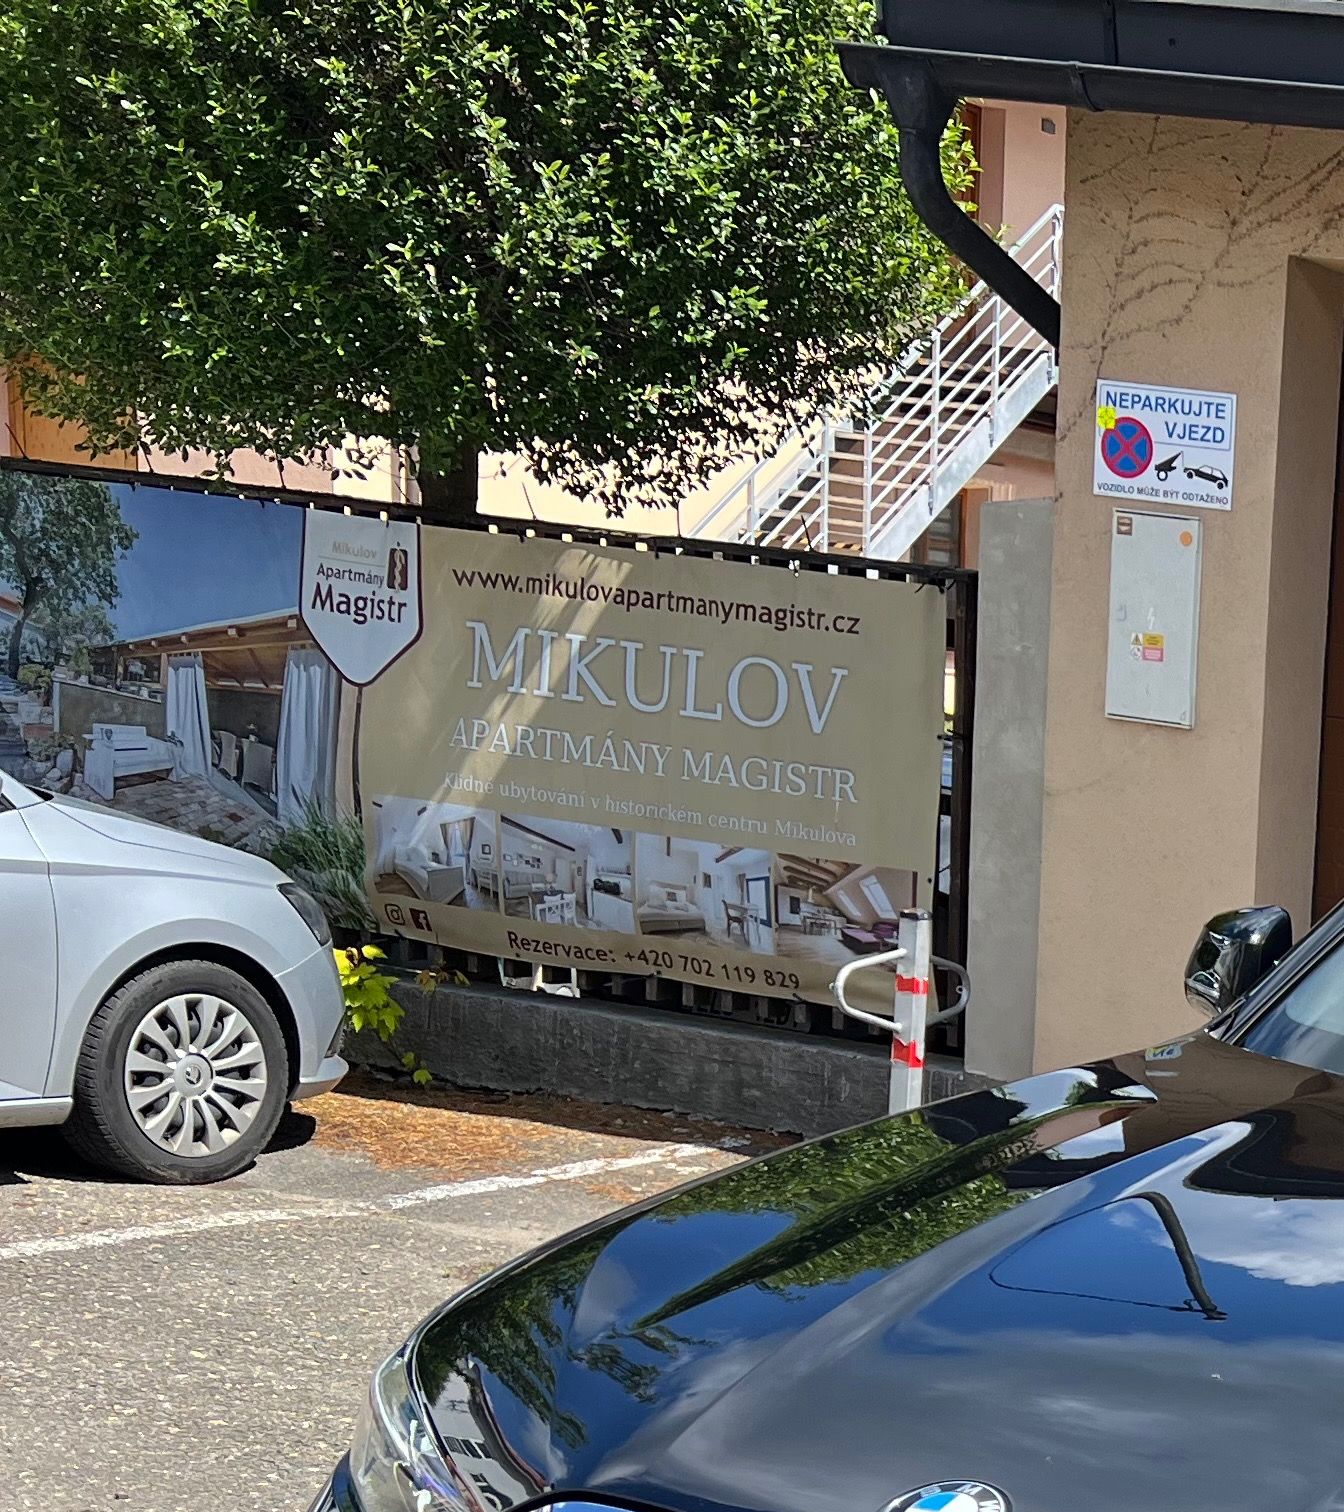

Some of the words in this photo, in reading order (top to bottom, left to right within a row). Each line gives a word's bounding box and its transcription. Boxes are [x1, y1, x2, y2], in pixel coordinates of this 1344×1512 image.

[1105, 390, 1227, 420] NEPARKUJTE
[1164, 420, 1226, 444] VJEZD
[1096, 481, 1135, 494] VOZIDLO
[1162, 487, 1180, 500] BÝT
[1181, 491, 1229, 505] ODTAŽENO
[331, 541, 378, 560] Mikulov
[316, 561, 385, 589] Apartmány
[311, 581, 408, 626] Magistr
[451, 567, 861, 636] www.mikulovapartmanymagistr.cz
[464, 620, 849, 735] MIKULOV
[449, 716, 673, 777] APARTMÁNY
[680, 748, 859, 804] MAGISTR
[499, 781, 586, 808] ubytování
[590, 795, 601, 810] v
[604, 793, 702, 825] historickém
[708, 813, 768, 834] centru
[774, 819, 857, 847] Mikulova
[506, 930, 616, 964] Rezervace:
[624, 949, 674, 969] +420
[677, 953, 716, 978] 702
[720, 962, 757, 984] 119
[763, 969, 801, 990] 829
